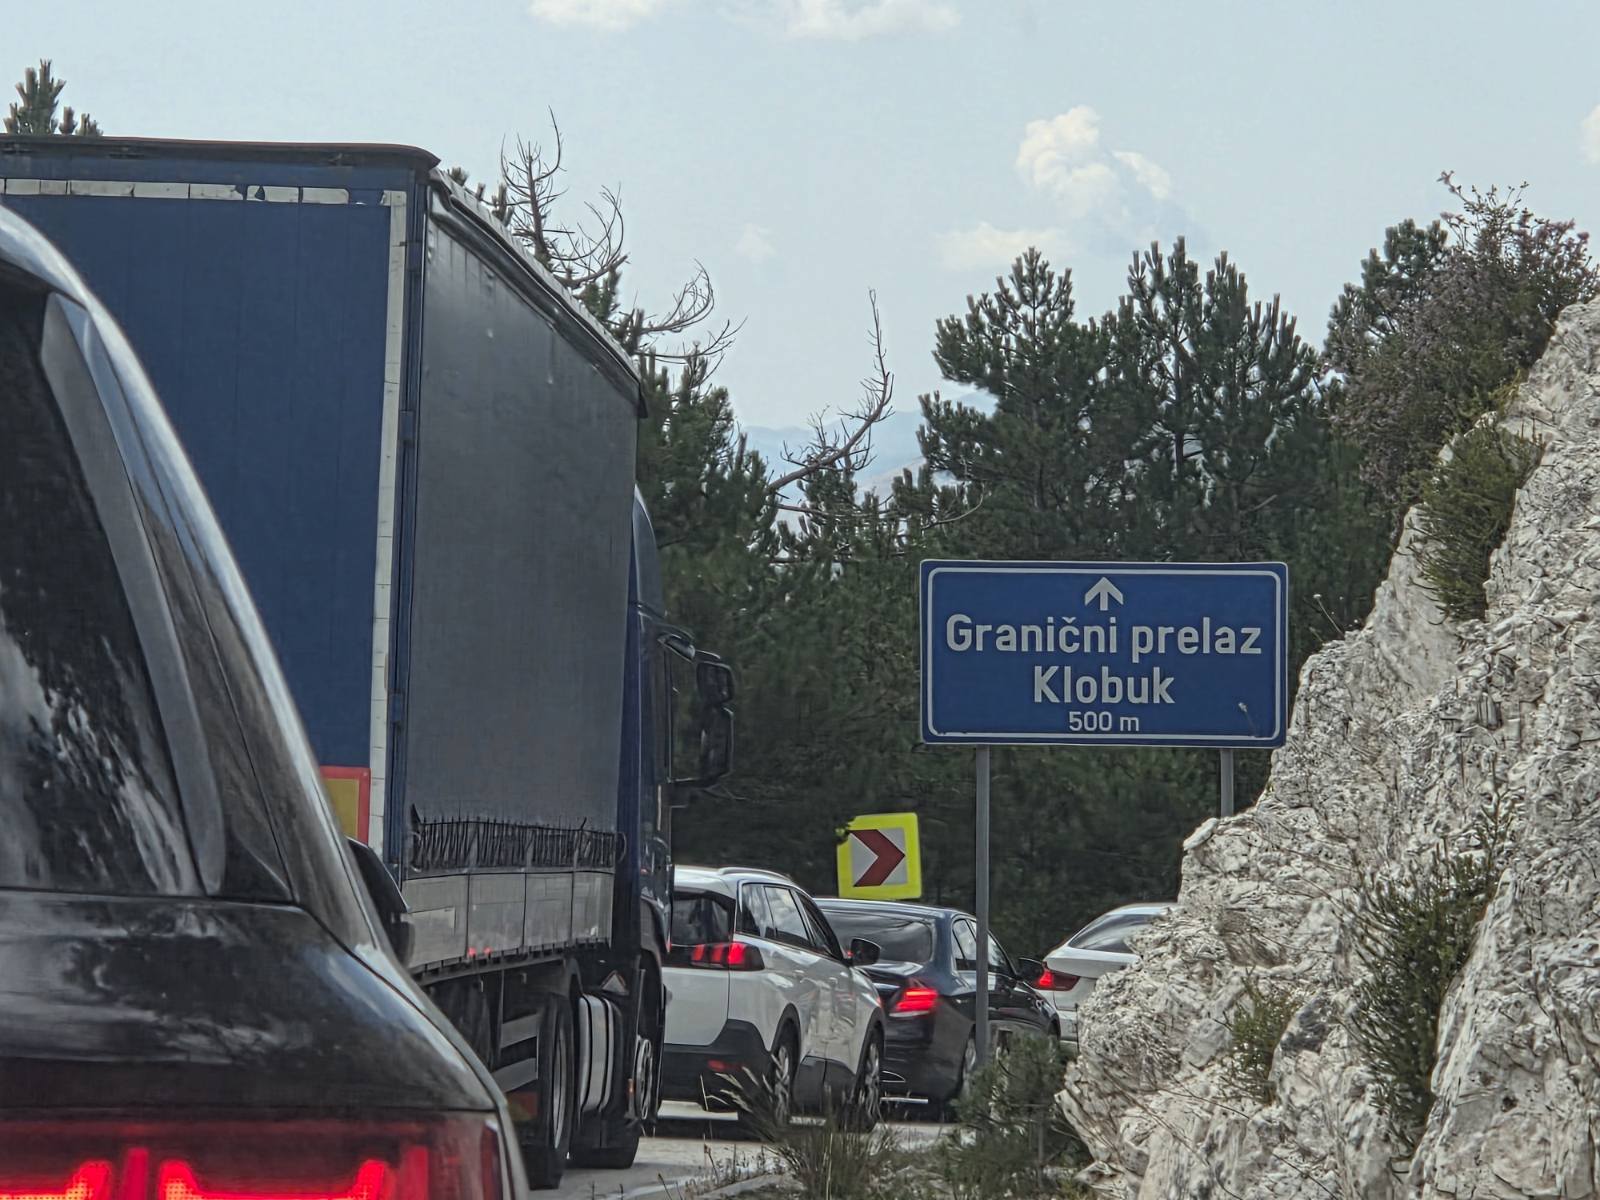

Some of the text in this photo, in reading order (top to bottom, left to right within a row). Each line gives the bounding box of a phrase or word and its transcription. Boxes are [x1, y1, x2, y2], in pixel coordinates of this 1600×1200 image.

[946, 613, 1262, 664] Granični prelaz
[1034, 665, 1175, 704] Klobuk
[1068, 711, 1140, 732] 500 m
